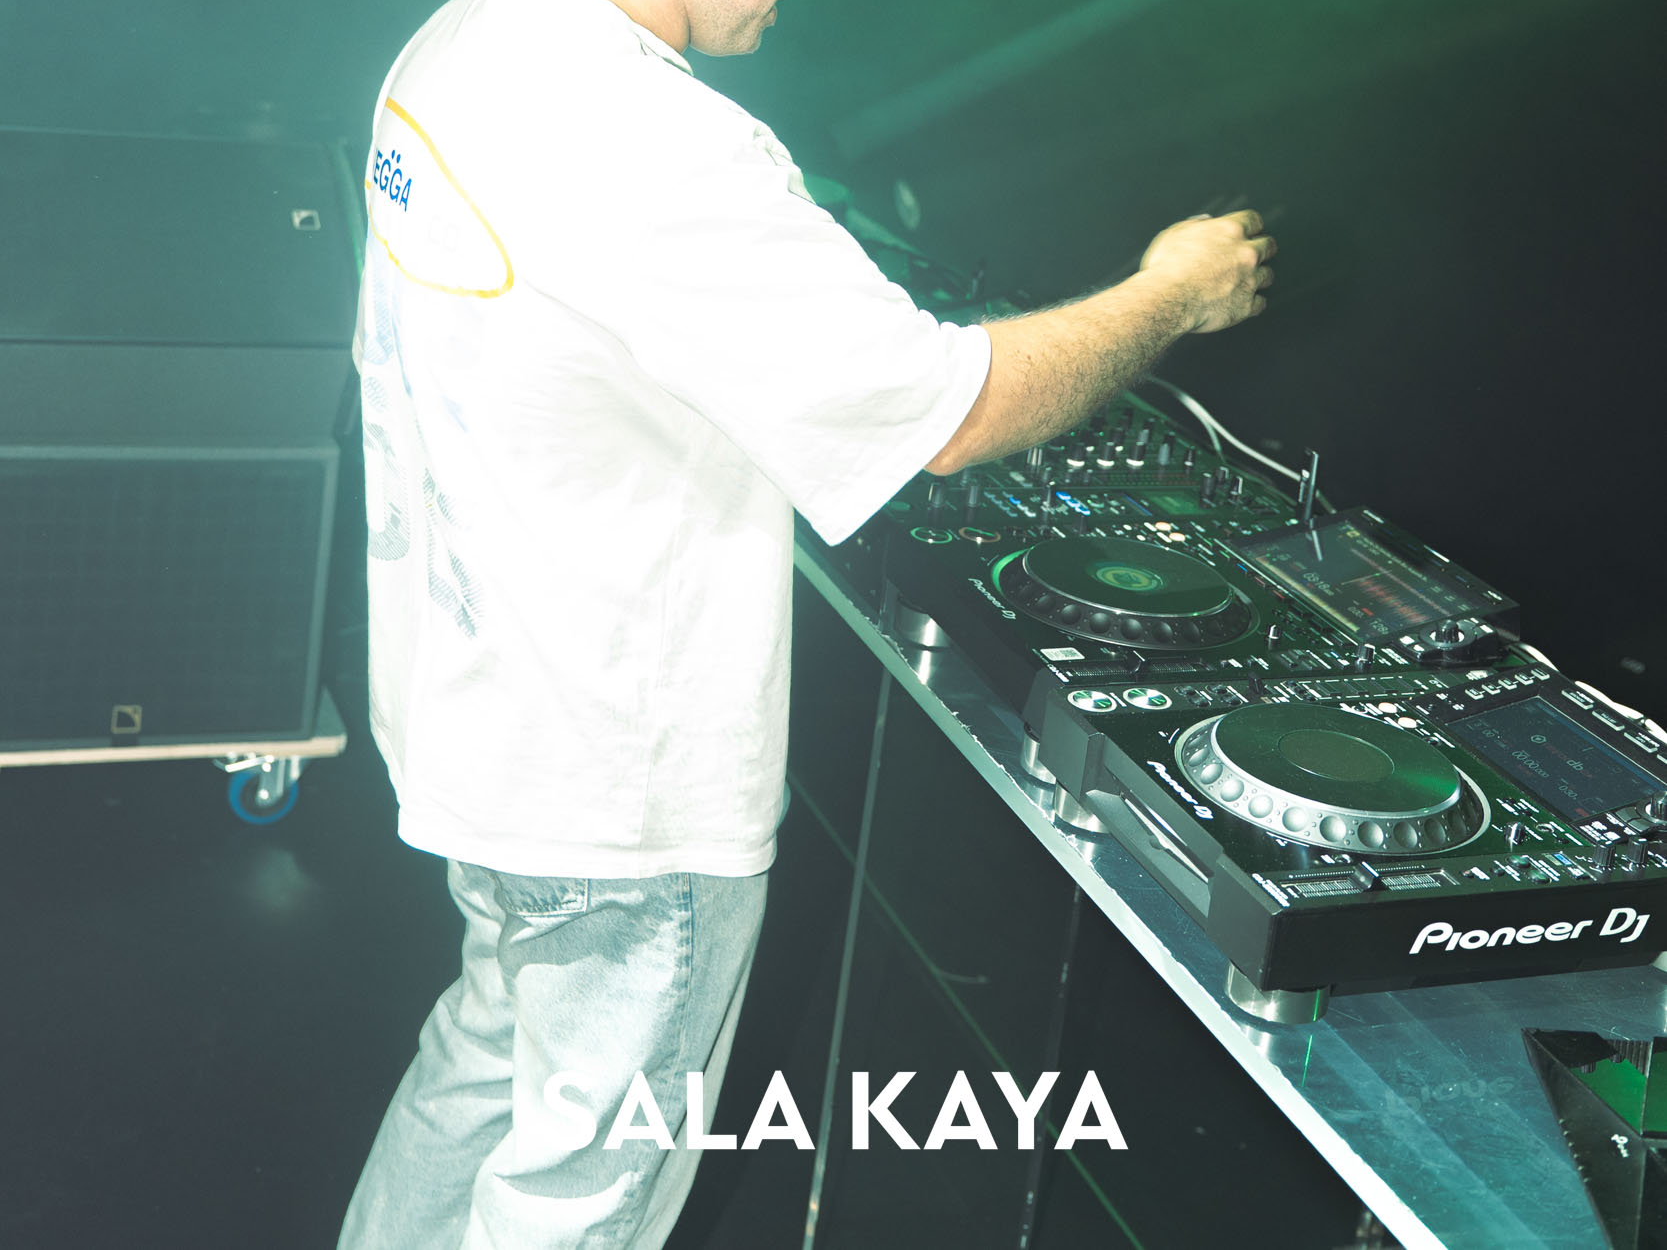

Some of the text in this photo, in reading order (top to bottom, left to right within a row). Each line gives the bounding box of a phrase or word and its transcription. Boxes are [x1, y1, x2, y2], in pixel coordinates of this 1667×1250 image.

[968, 577, 1006, 610] Pioneer
[1147, 760, 1198, 806] Pioneer
[1409, 907, 1651, 955] Pioneer DJ
